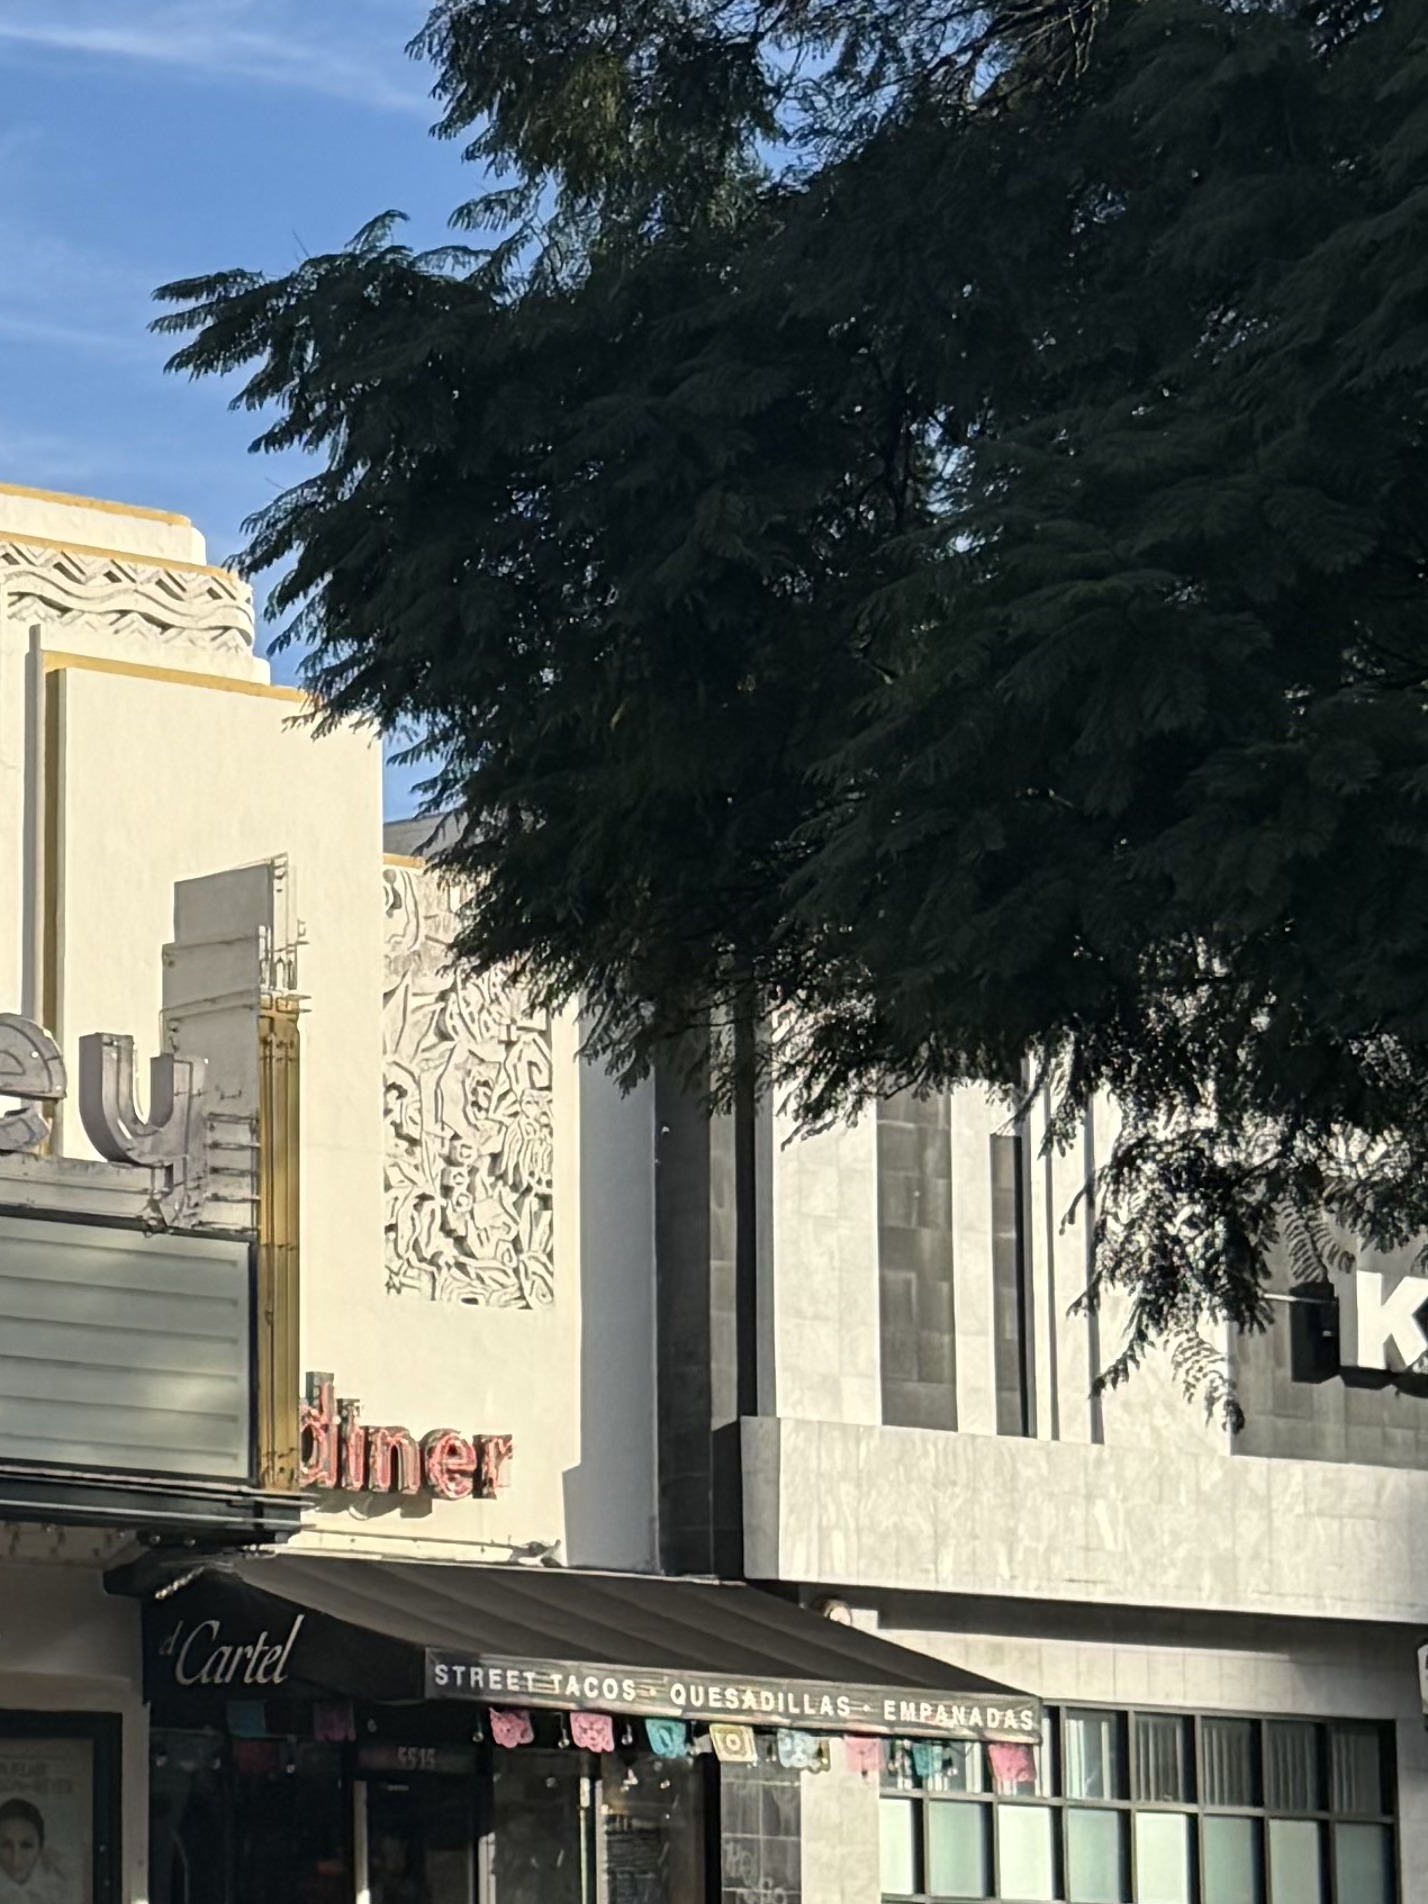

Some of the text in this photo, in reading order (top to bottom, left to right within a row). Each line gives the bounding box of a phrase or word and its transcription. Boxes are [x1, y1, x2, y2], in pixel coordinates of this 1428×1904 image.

[299, 1371, 513, 1501] diner
[175, 1613, 305, 1686] Cartel
[434, 1663, 1035, 1731] STREET TACOS QUESADILLAS EMPANADAS
